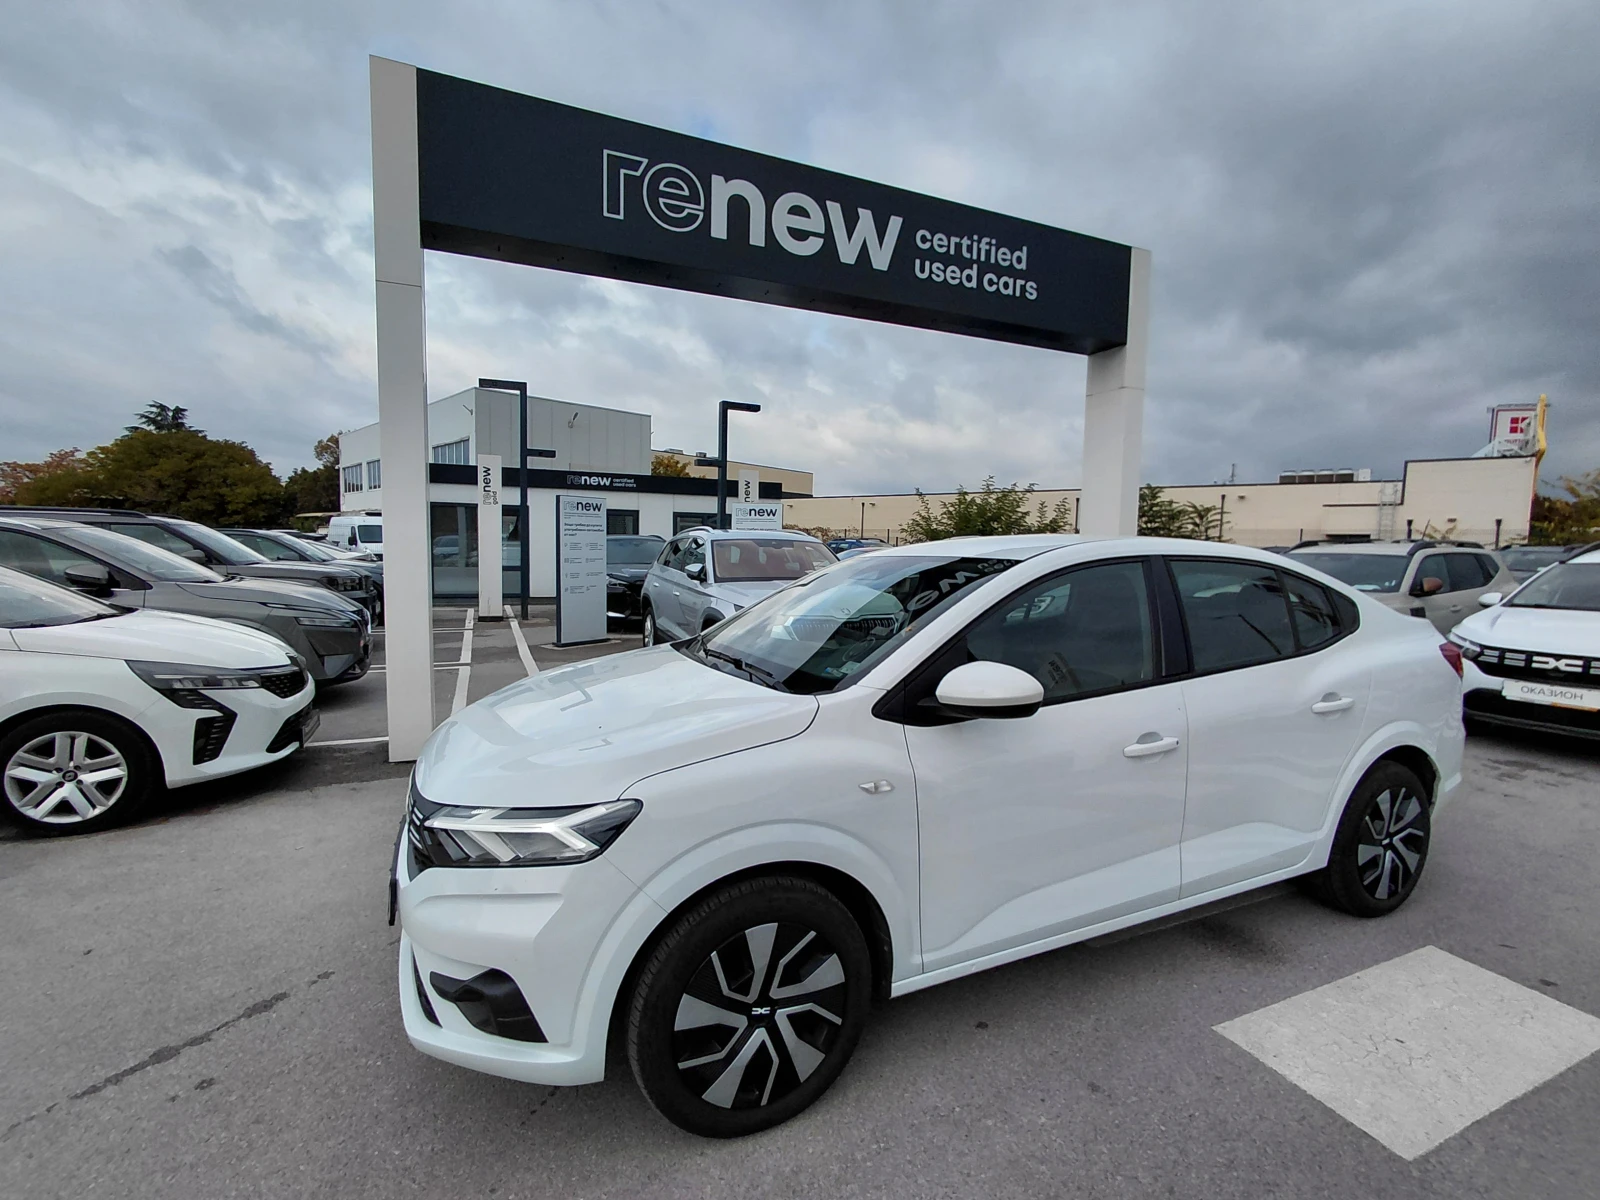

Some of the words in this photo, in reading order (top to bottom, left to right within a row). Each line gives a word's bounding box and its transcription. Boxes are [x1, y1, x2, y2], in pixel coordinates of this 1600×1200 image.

[602, 148, 904, 272] renew
[915, 227, 1027, 271] certified
[914, 258, 977, 288] used
[982, 271, 1038, 301] cars
[482, 465, 492, 506] renew
[566, 474, 612, 486] renew
[563, 500, 602, 512] renew
[735, 507, 778, 517] renew
[1520, 685, 1583, 700] ОКАЗИОН
